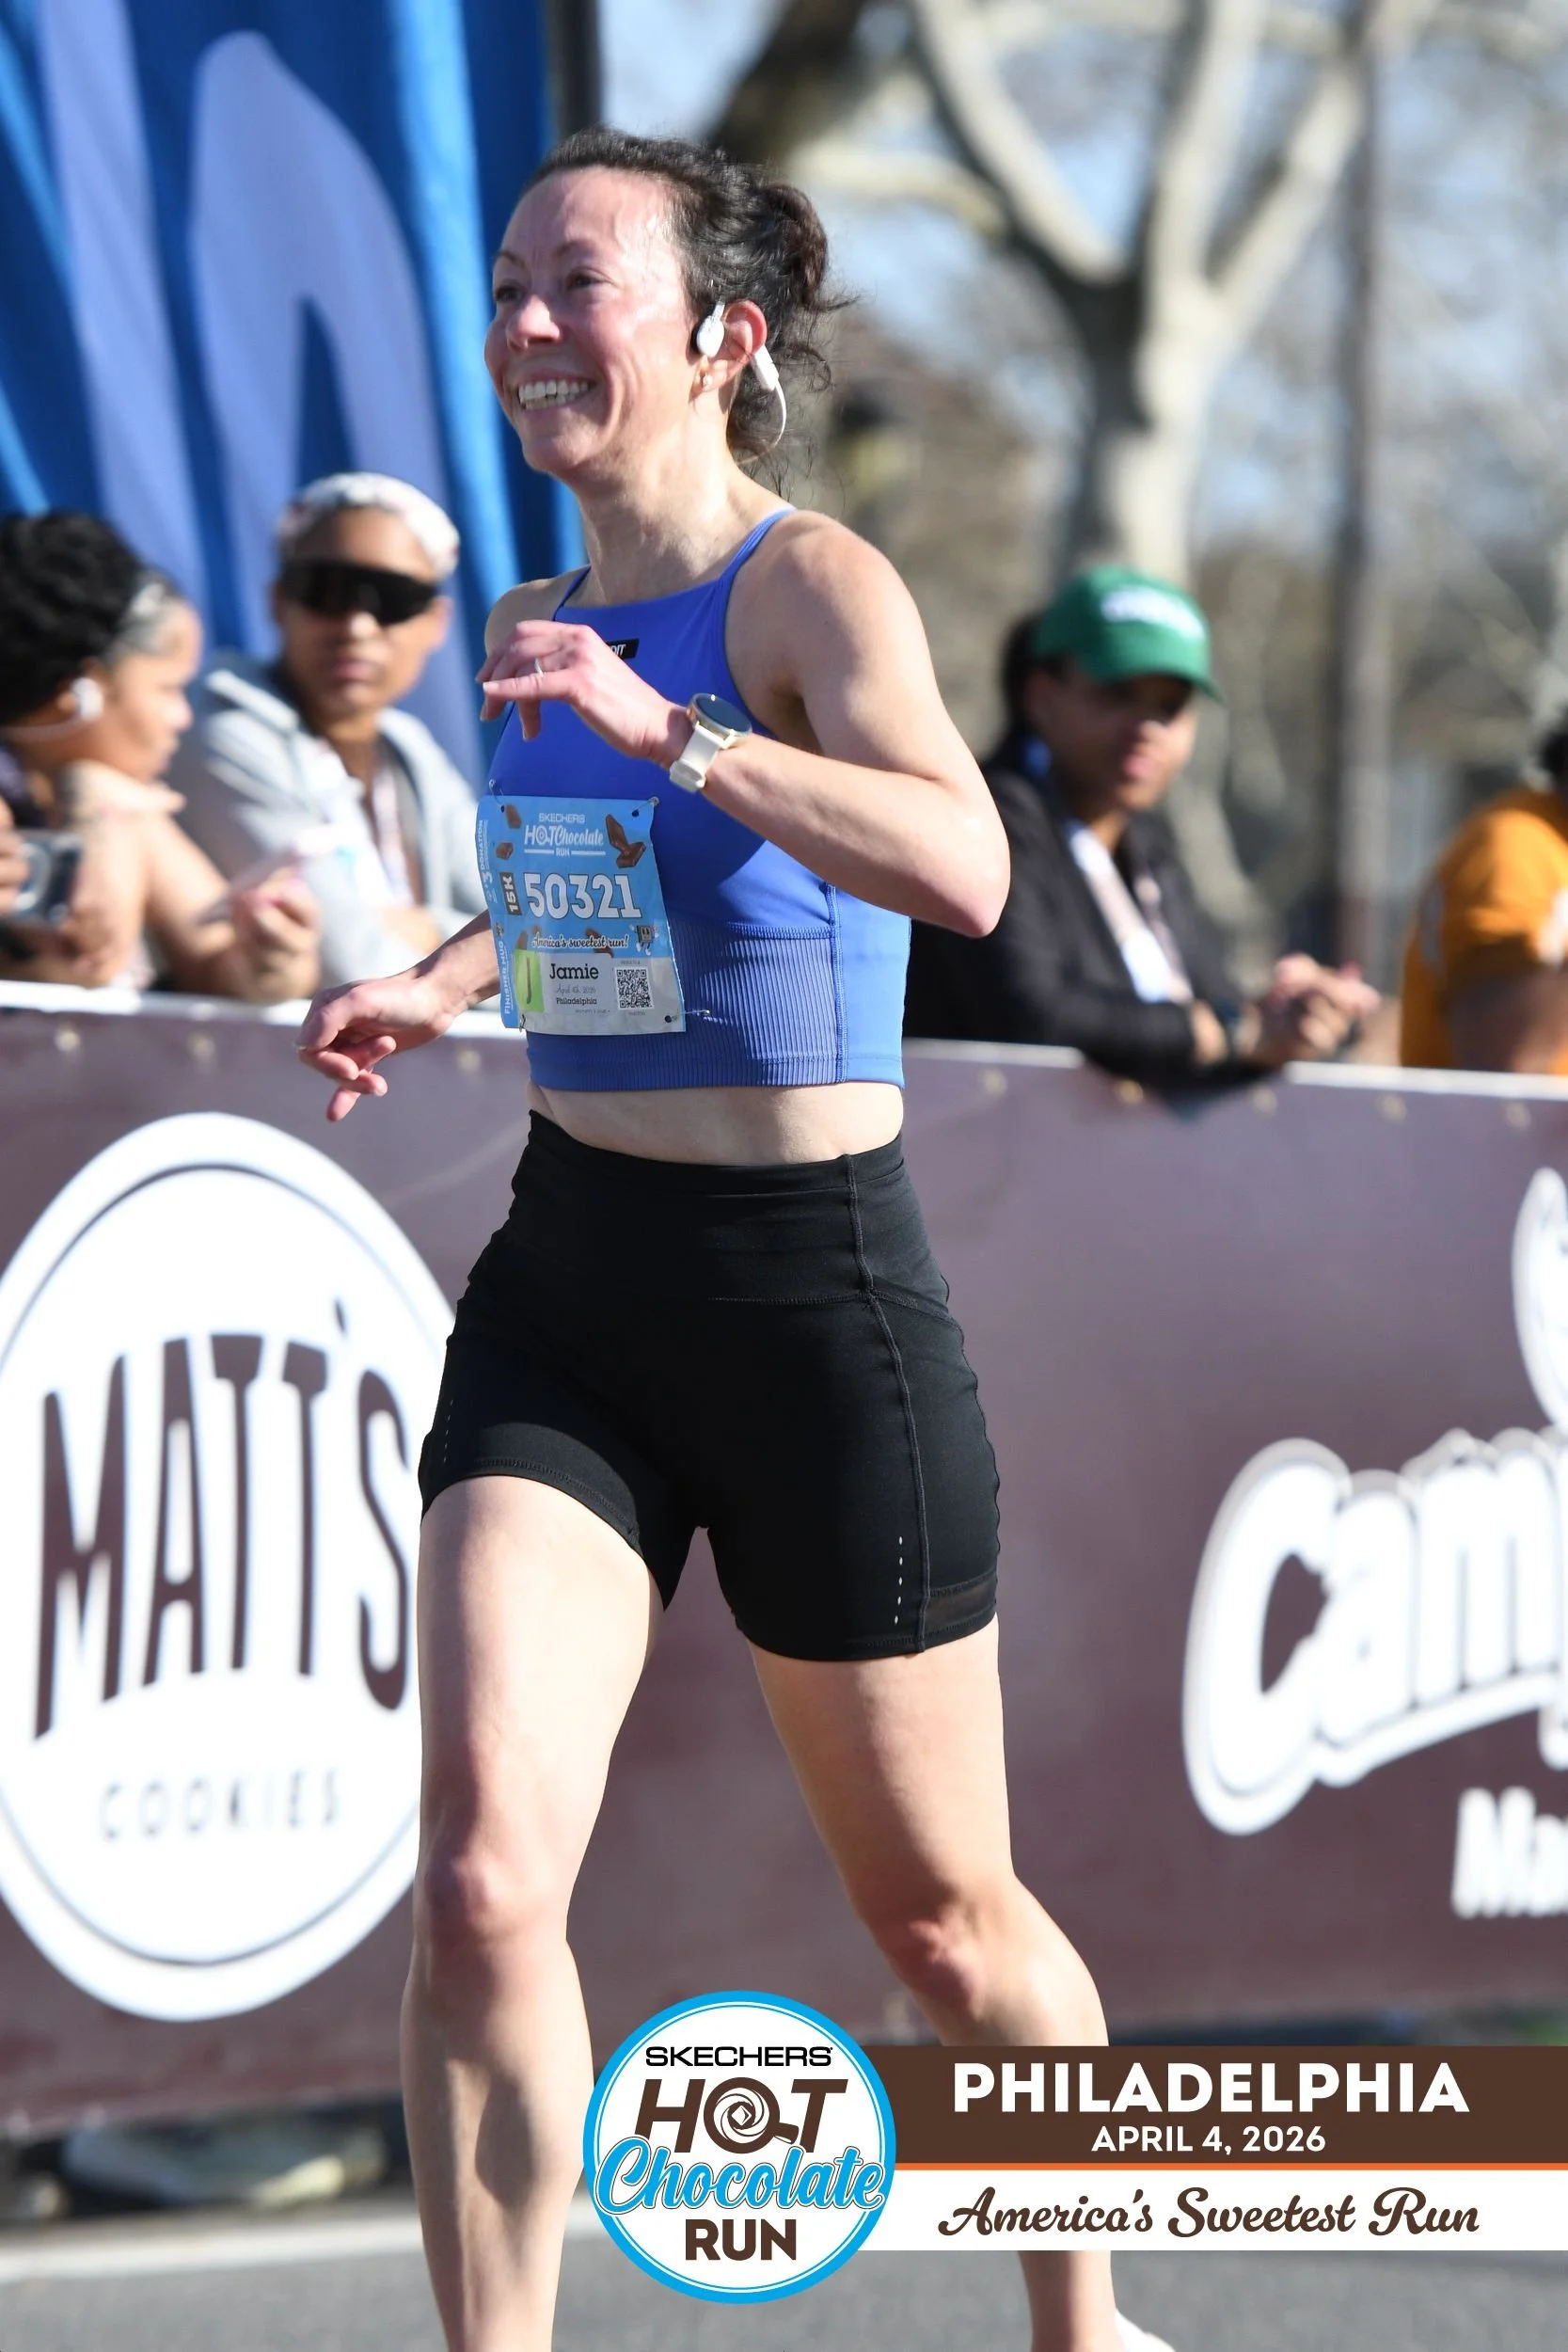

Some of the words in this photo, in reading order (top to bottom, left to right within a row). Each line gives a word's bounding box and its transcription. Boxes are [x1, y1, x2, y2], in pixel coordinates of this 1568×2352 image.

[538, 813, 586, 824] SKECHERS
[555, 824, 605, 847] Chocolate
[502, 875, 519, 913] 15K
[524, 871, 642, 919] 50321
[567, 933, 607, 949] sweetest
[608, 933, 629, 948] run!
[549, 962, 599, 979] Jamie
[501, 968, 512, 1014] FINISHER
[556, 997, 597, 1006] Philadelphia
[32, 1296, 411, 1742] MATT'S
[1182, 1427, 1568, 1836] Cam
[98, 1766, 342, 1843] COOKIES
